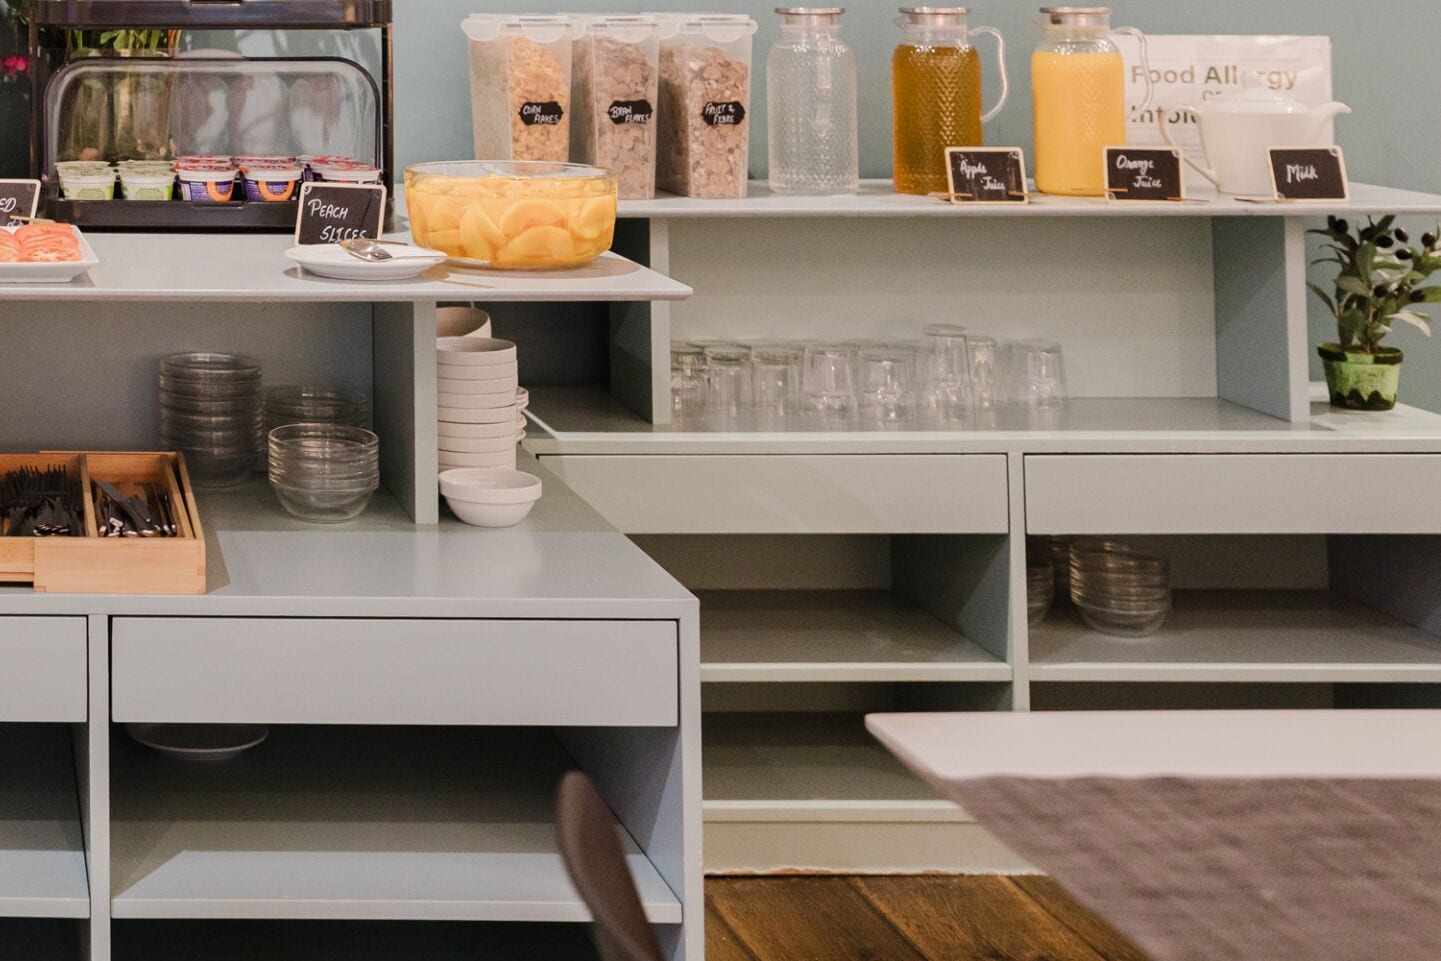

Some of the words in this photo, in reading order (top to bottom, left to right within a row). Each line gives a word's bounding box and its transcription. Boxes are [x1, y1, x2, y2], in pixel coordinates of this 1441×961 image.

[1131, 65, 1195, 85] Food
[610, 105, 632, 118] BRAN
[960, 159, 988, 179] Apple
[1116, 154, 1154, 175] Orange
[1285, 164, 1318, 184] Milk
[982, 176, 1006, 190] Juice
[1133, 175, 1162, 188] Juice
[307, 198, 349, 220] PEACH
[319, 225, 367, 243] SLICES
